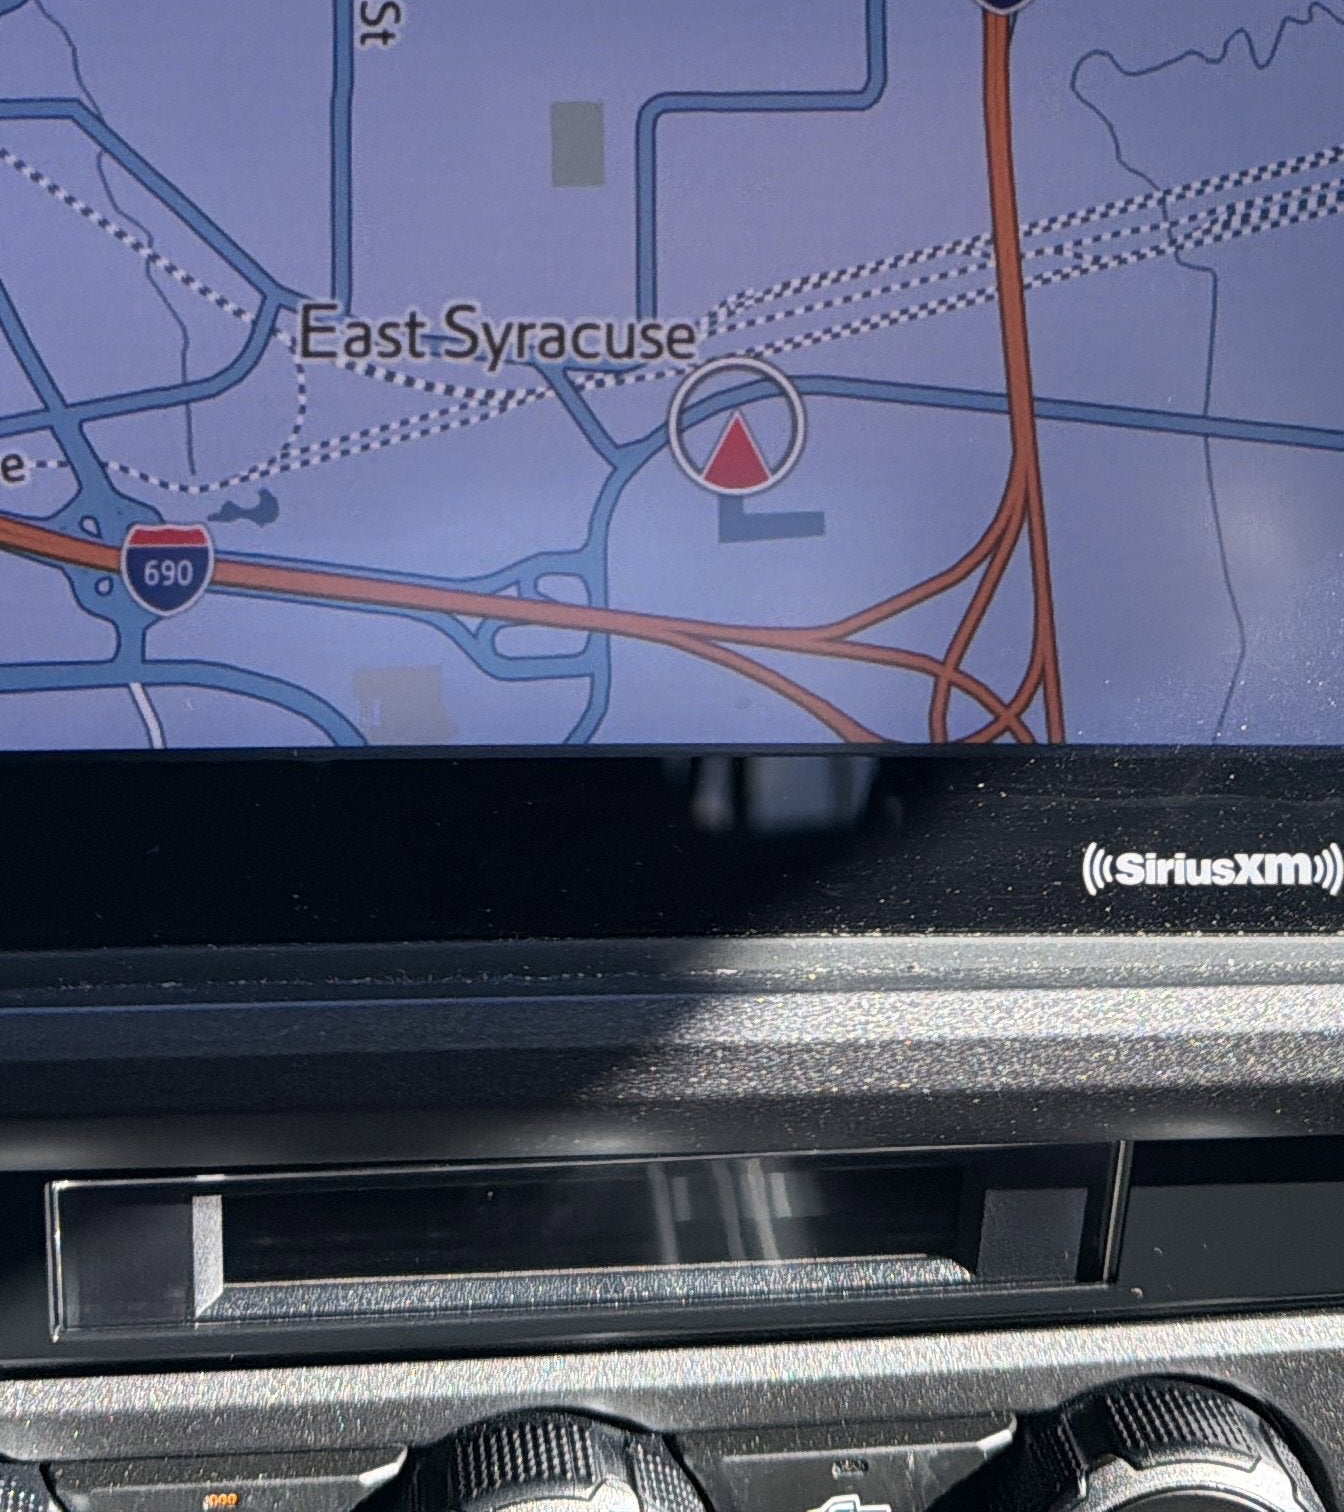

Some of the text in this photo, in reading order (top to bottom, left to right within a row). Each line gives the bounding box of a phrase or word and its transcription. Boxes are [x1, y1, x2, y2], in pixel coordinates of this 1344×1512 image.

[358, 0, 403, 47] St
[300, 305, 697, 371] East Syracuse
[143, 559, 194, 586] 690
